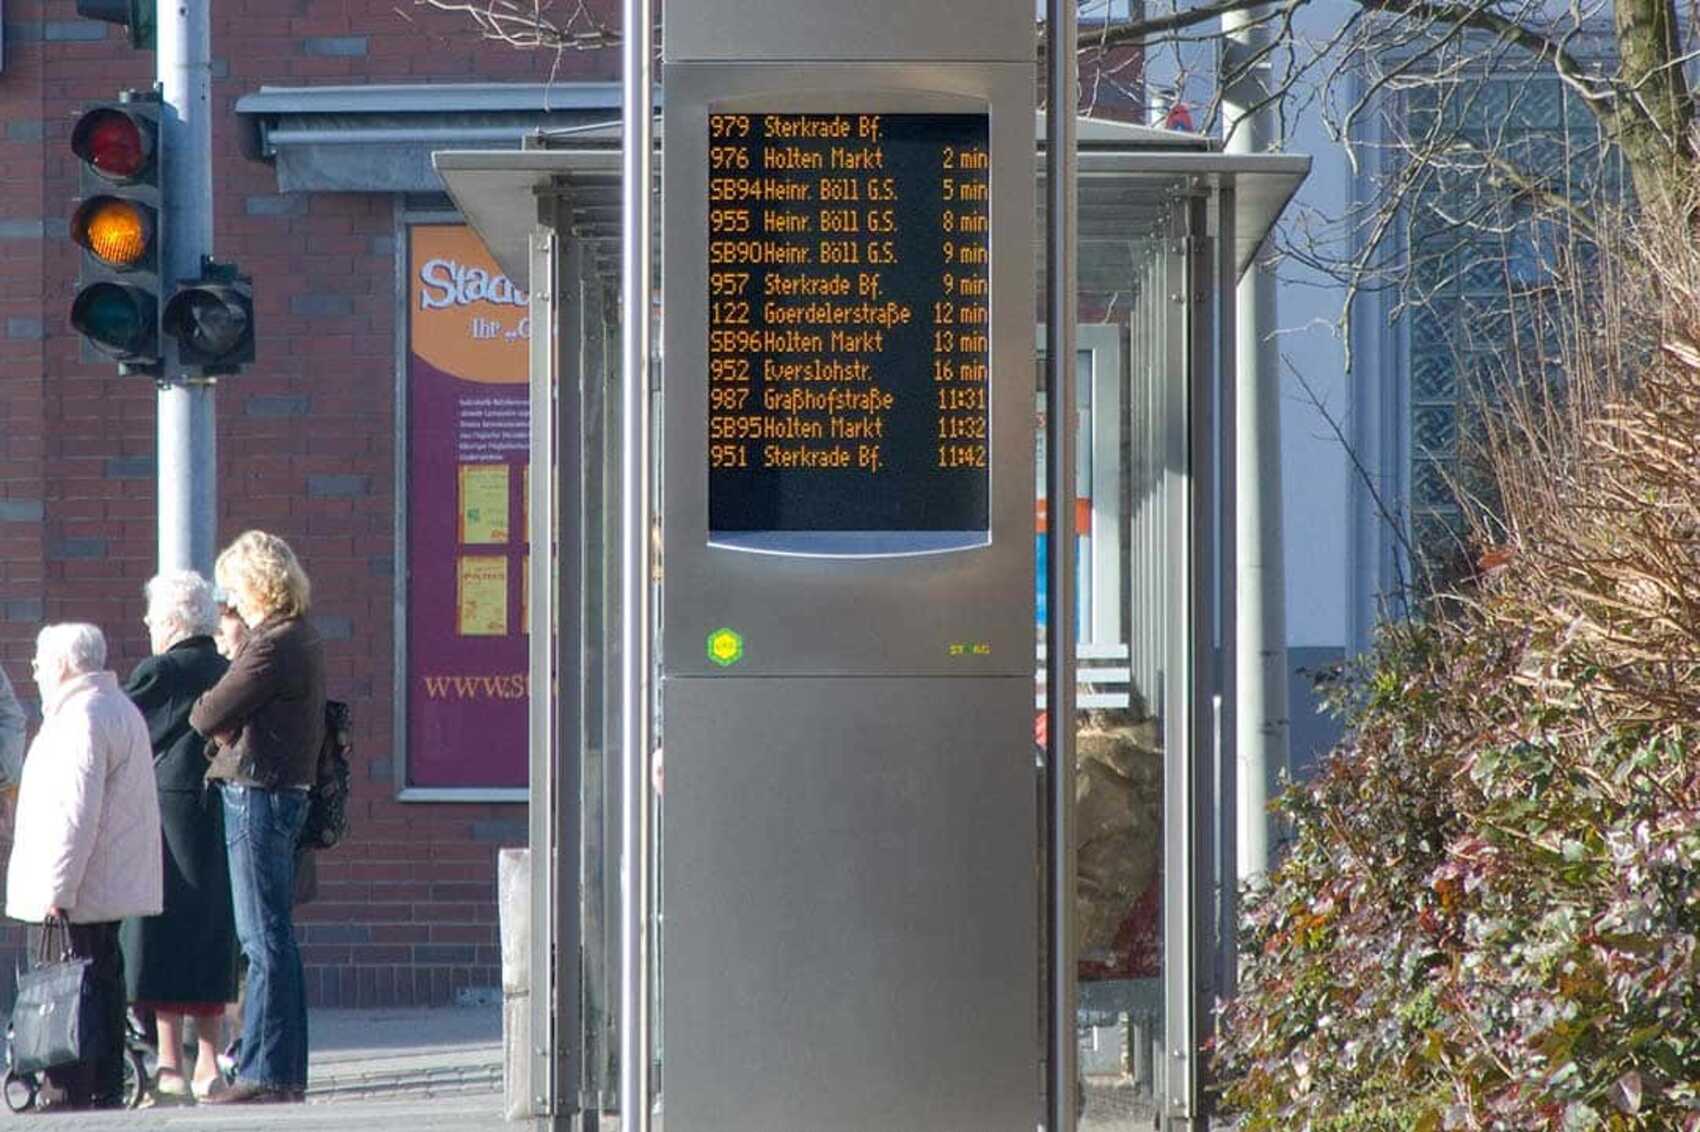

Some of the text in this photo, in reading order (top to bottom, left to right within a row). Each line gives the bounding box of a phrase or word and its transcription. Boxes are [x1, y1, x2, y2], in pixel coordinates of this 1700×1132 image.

[710, 116, 883, 142] 979 Sterkrade Bf.
[710, 148, 987, 168] 976 Holten Markt 2 min
[711, 179, 761, 200] SB94
[820, 179, 858, 200] Böll
[867, 179, 898, 200] G.S.
[943, 179, 953, 200] 5
[960, 180, 987, 200] min
[710, 210, 748, 231] 955
[820, 210, 858, 231] Böll
[867, 211, 898, 231] G.S.
[942, 211, 953, 231] 8
[960, 211, 987, 231] min
[710, 242, 762, 263] SB90
[820, 242, 858, 263] Böll
[867, 242, 898, 263] G.S.
[943, 242, 953, 263] 9
[960, 243, 987, 263] min
[710, 273, 987, 298] 957 Sterkrade Bf. 9 min
[711, 302, 987, 328] 122 Goerdelerstraße 12 min
[710, 331, 987, 352] SB96 Holten Markt 13 min
[710, 359, 749, 380] 952
[934, 360, 953, 380] 16
[959, 360, 987, 381] min
[710, 388, 985, 414] 987 Graßhofstraße 11:31
[710, 416, 986, 438] SB95 Holten Markt 11:32
[710, 445, 986, 471] 951 Sterkrade Bf. 11:42
[424, 675, 528, 699] www.s
